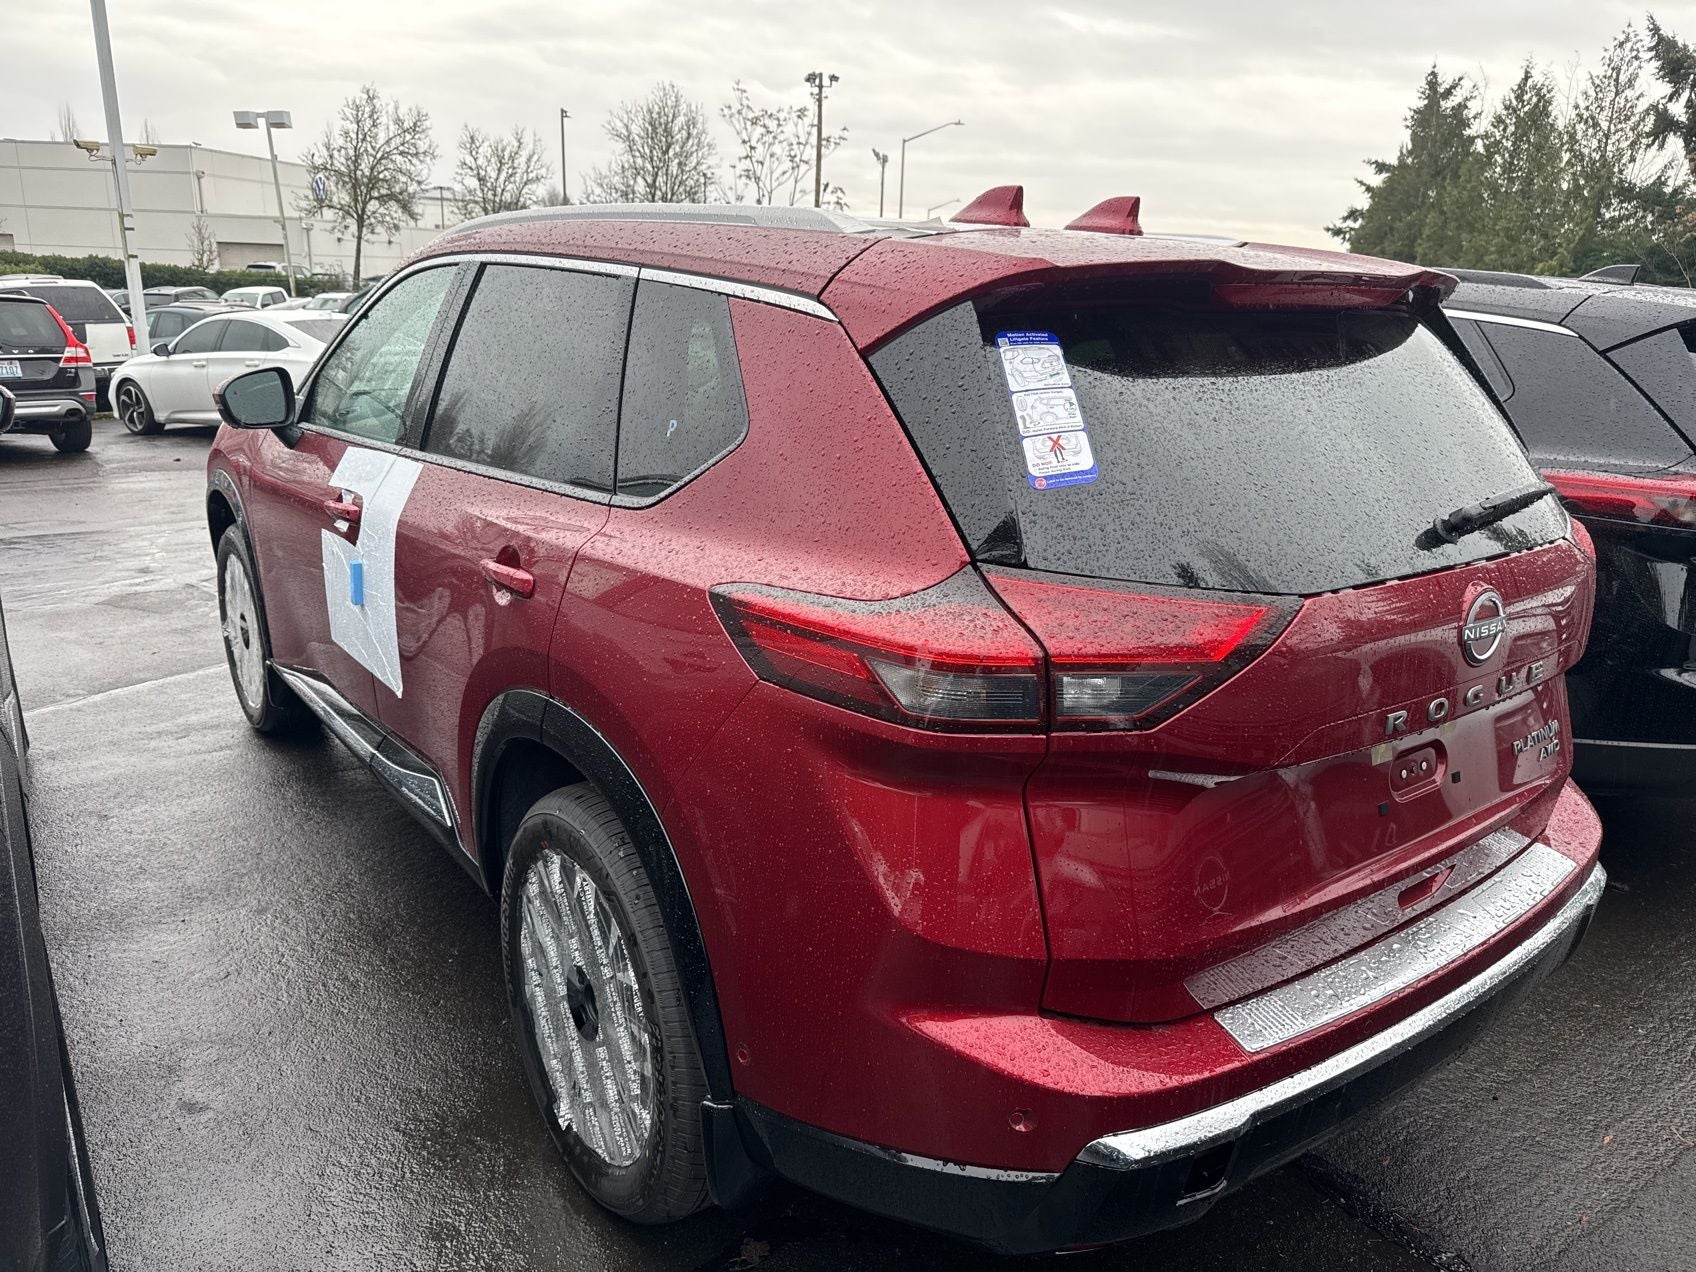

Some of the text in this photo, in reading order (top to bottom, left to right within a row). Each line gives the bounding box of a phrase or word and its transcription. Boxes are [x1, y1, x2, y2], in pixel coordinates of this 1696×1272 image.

[1385, 661, 1544, 735] ROGUE
[1513, 720, 1559, 754] PLATINUM
[1539, 740, 1560, 762] AWD
